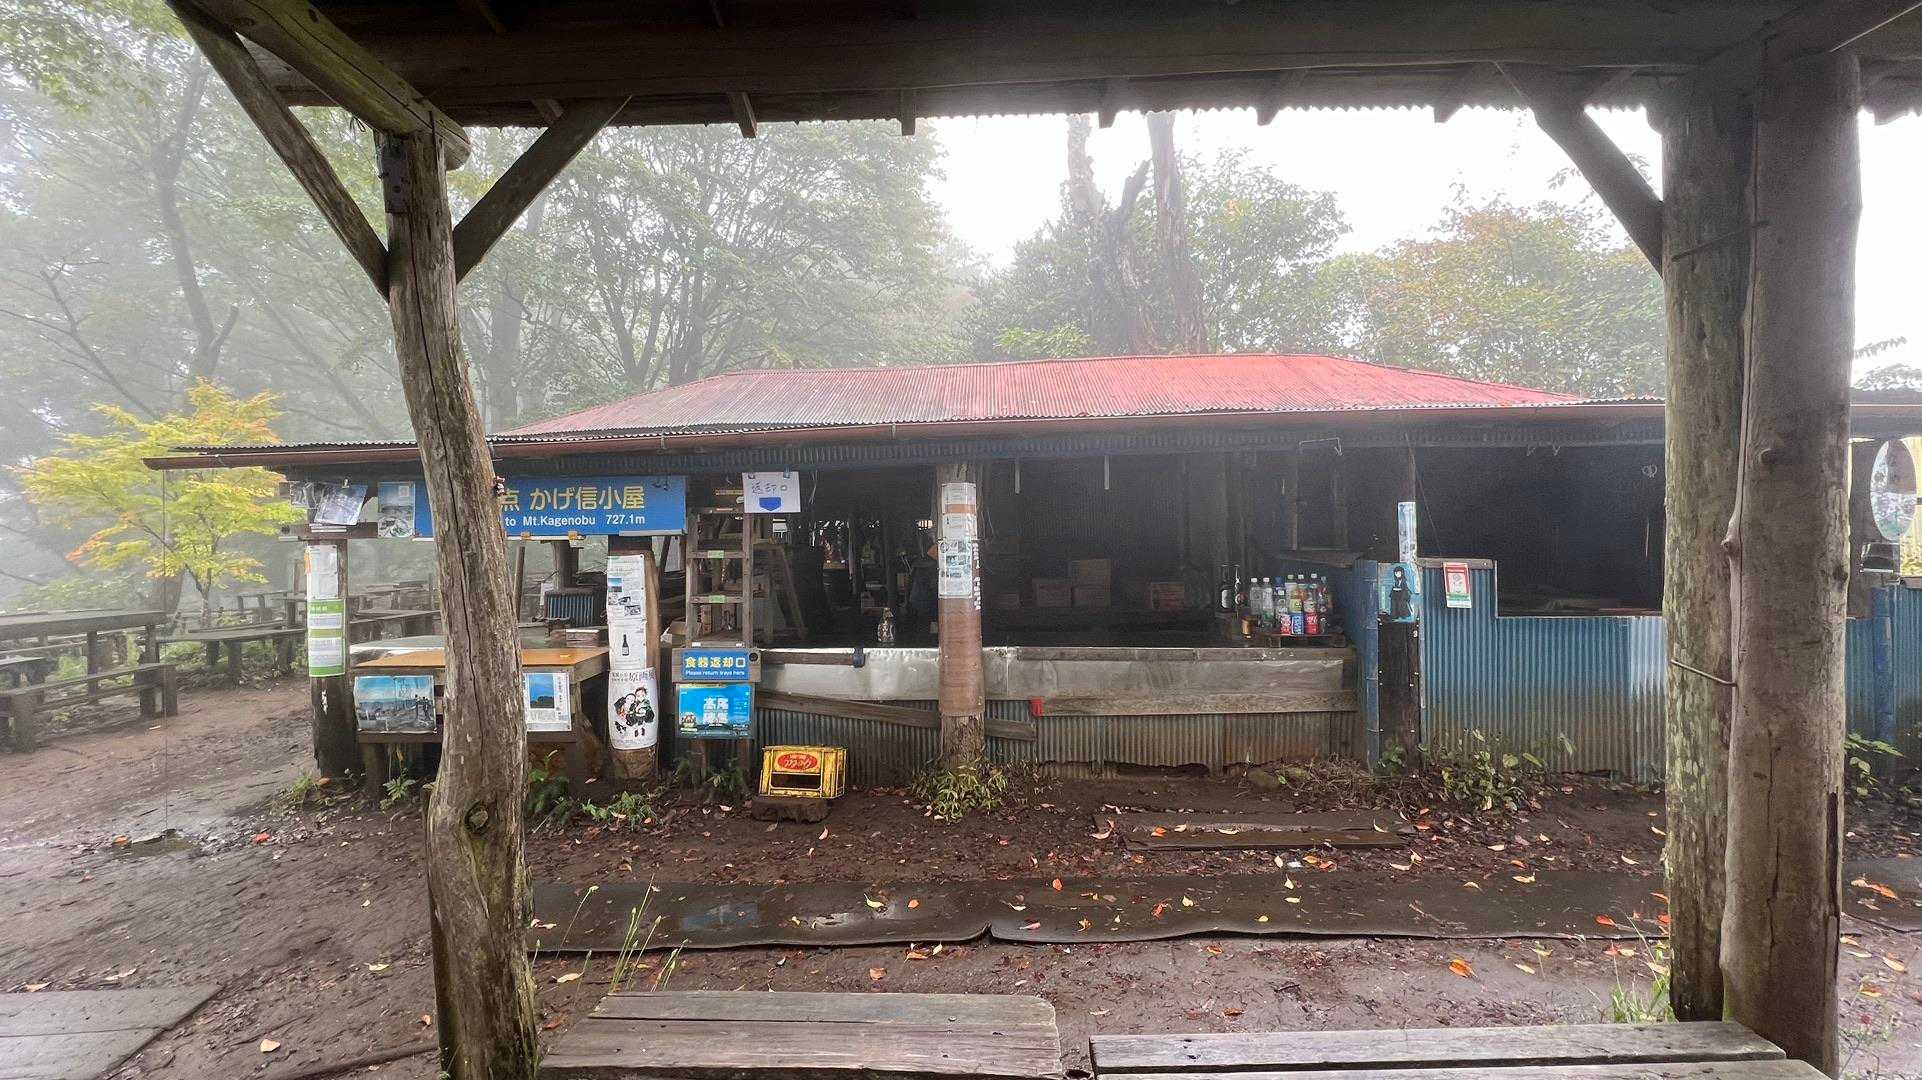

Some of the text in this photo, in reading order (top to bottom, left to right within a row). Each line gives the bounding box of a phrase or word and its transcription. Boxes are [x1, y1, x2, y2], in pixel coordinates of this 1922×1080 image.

[529, 486, 645, 511] かげ信小屋
[504, 516, 517, 527] to
[605, 514, 646, 525] 727.1m
[685, 656, 746, 669] 食器返却口
